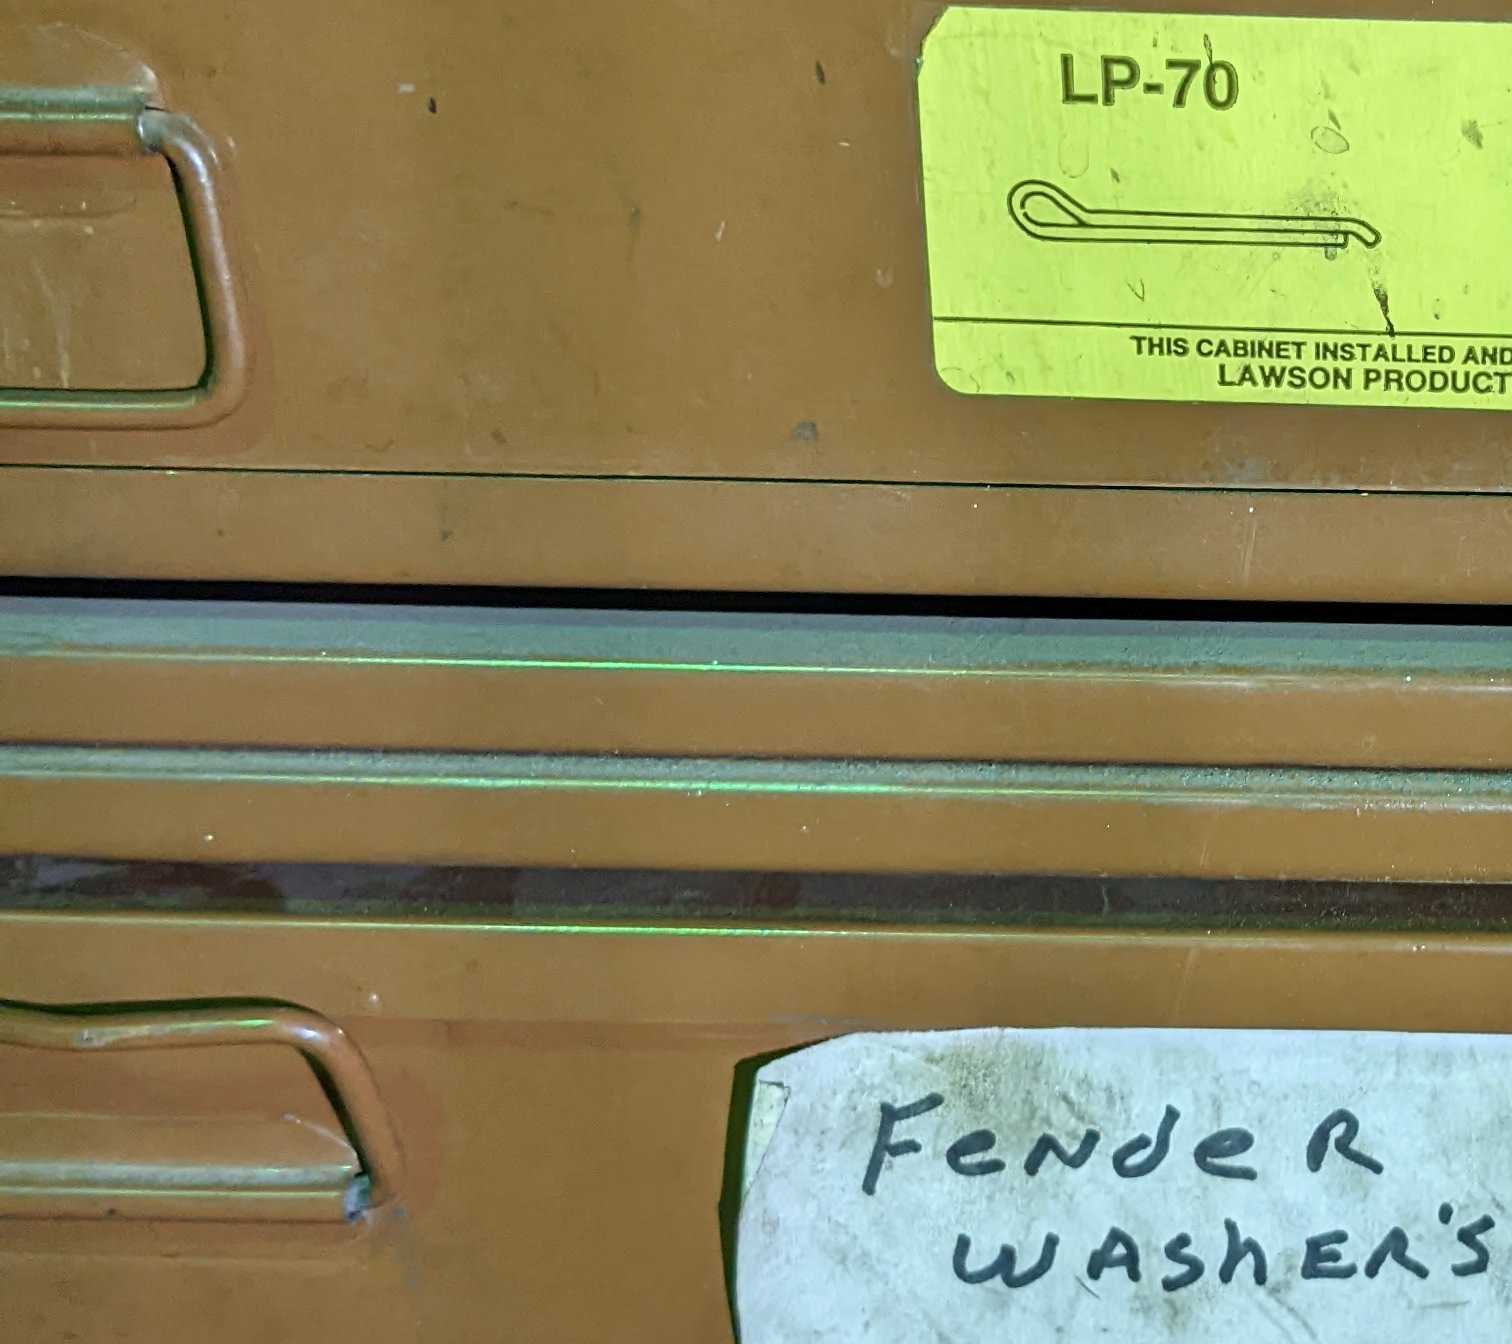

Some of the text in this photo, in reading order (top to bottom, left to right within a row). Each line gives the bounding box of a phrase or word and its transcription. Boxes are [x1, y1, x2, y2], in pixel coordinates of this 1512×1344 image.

[1060, 53, 1239, 111] LP-70
[1130, 336, 1189, 357] THIS
[1196, 338, 1307, 361] CABINET
[1315, 341, 1456, 364] INSTALLED
[1217, 363, 1352, 390] LAWSON
